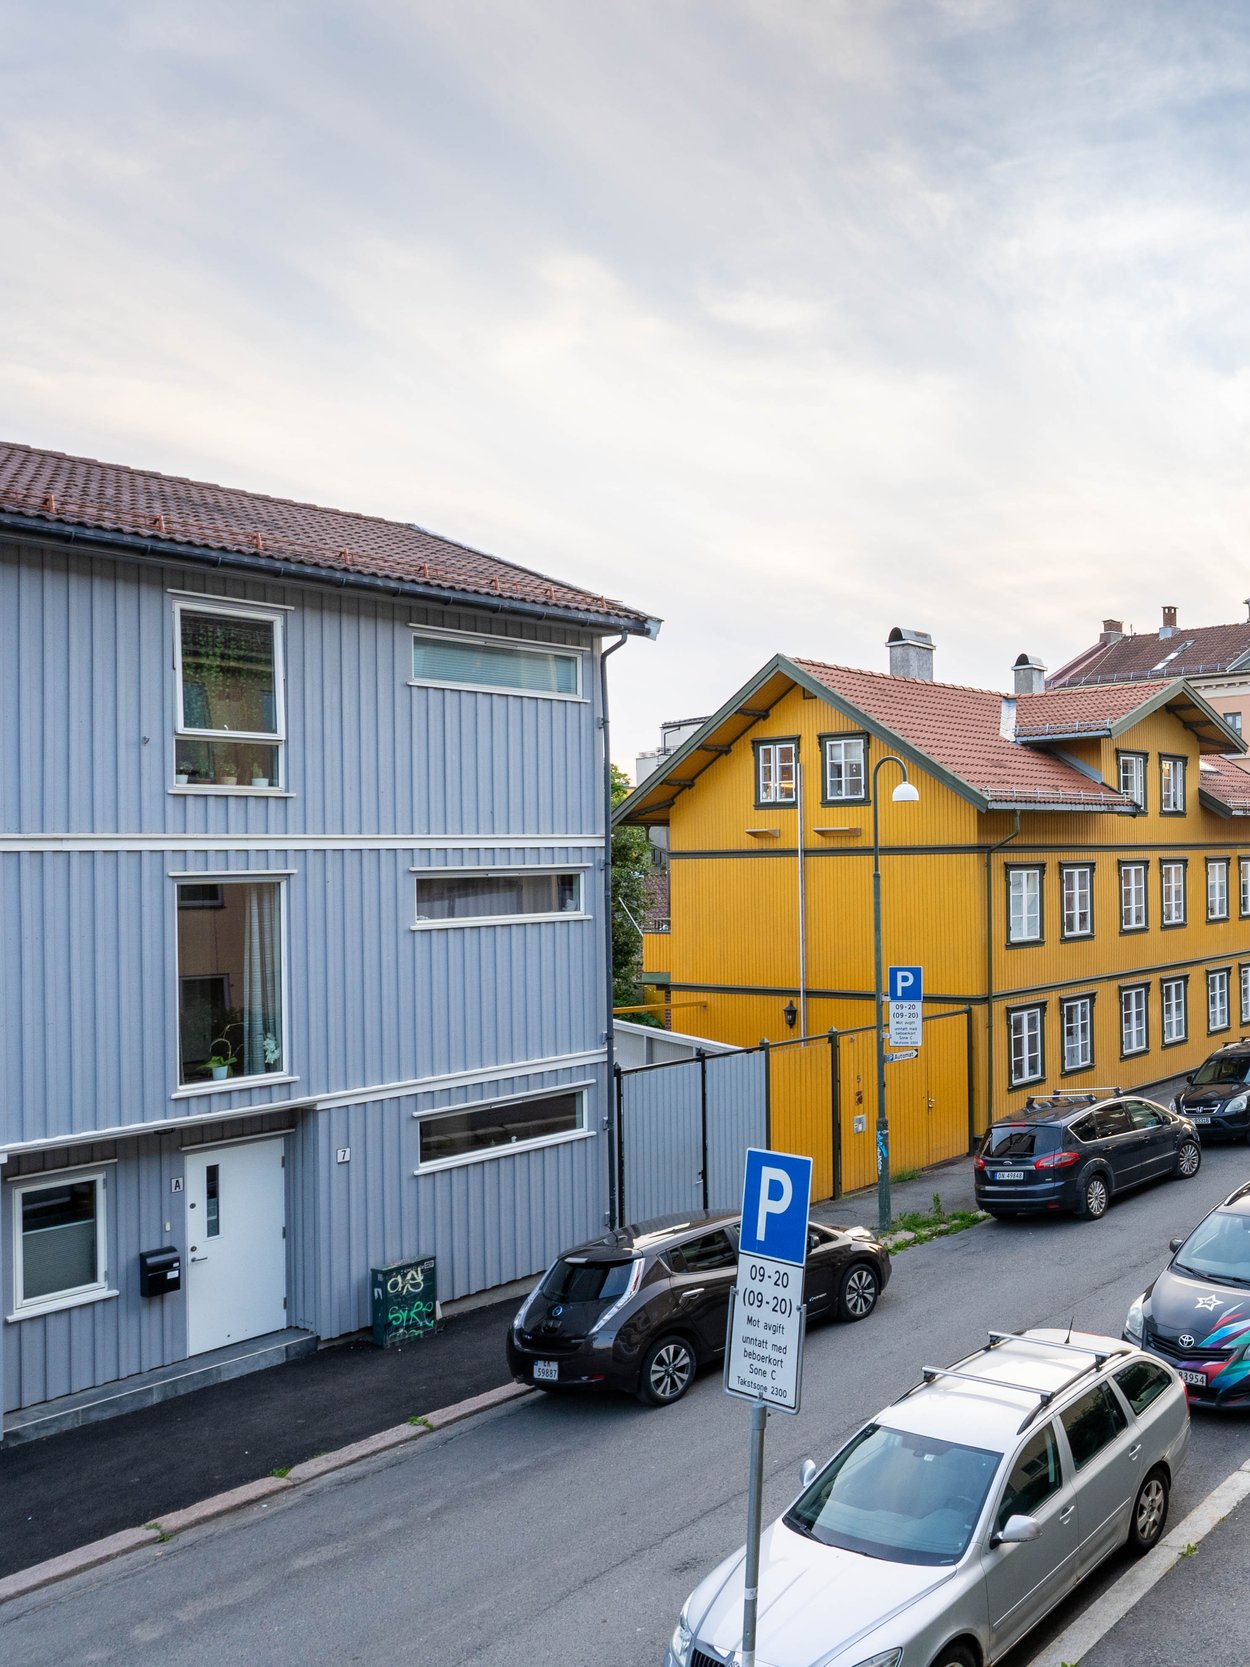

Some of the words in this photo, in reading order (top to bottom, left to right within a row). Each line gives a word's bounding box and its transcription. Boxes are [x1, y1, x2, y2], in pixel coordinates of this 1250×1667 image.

[896, 971, 915, 997] P
[340, 1149, 347, 1160] 7
[173, 1179, 181, 1191] A
[755, 1165, 793, 1241] P
[750, 1264, 789, 1288] 09-20
[743, 1287, 792, 1318] (09-20)
[746, 1314, 760, 1328] Mot
[763, 1322, 785, 1335] avgift
[741, 1335, 768, 1350] unntatt
[771, 1343, 787, 1355] med
[743, 1348, 783, 1368] beboerkort
[537, 1367, 557, 1378] 59887
[749, 1363, 767, 1378] Sone
[770, 1369, 777, 1381] C
[737, 1375, 768, 1393] Takstsone
[770, 1385, 787, 1399] 2300
